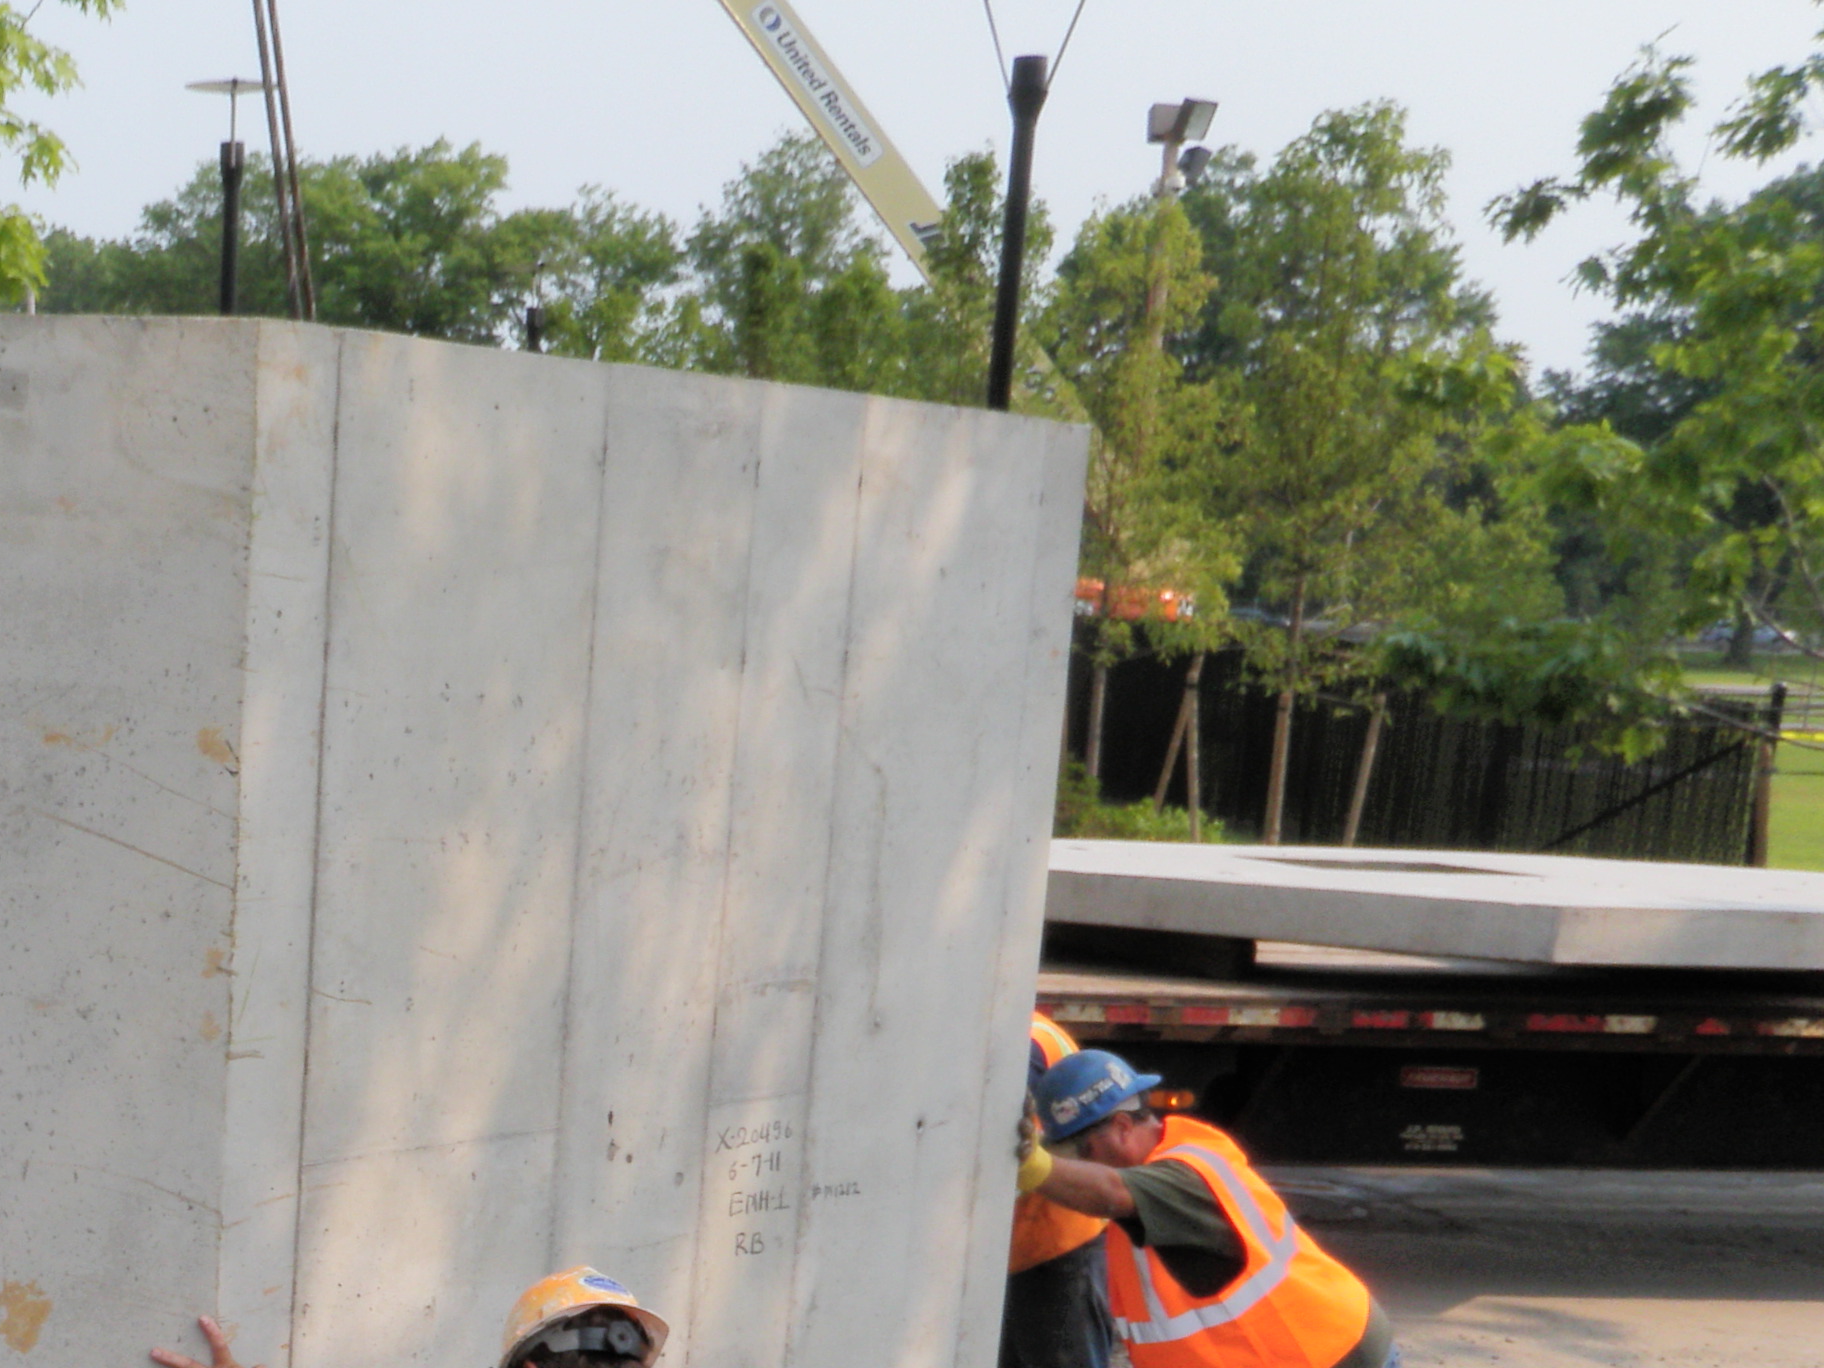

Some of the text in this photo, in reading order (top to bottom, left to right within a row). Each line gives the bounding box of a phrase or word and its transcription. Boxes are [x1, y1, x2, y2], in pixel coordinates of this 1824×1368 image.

[777, 31, 871, 156] United Rentals
[734, 1232, 765, 1256] RB
